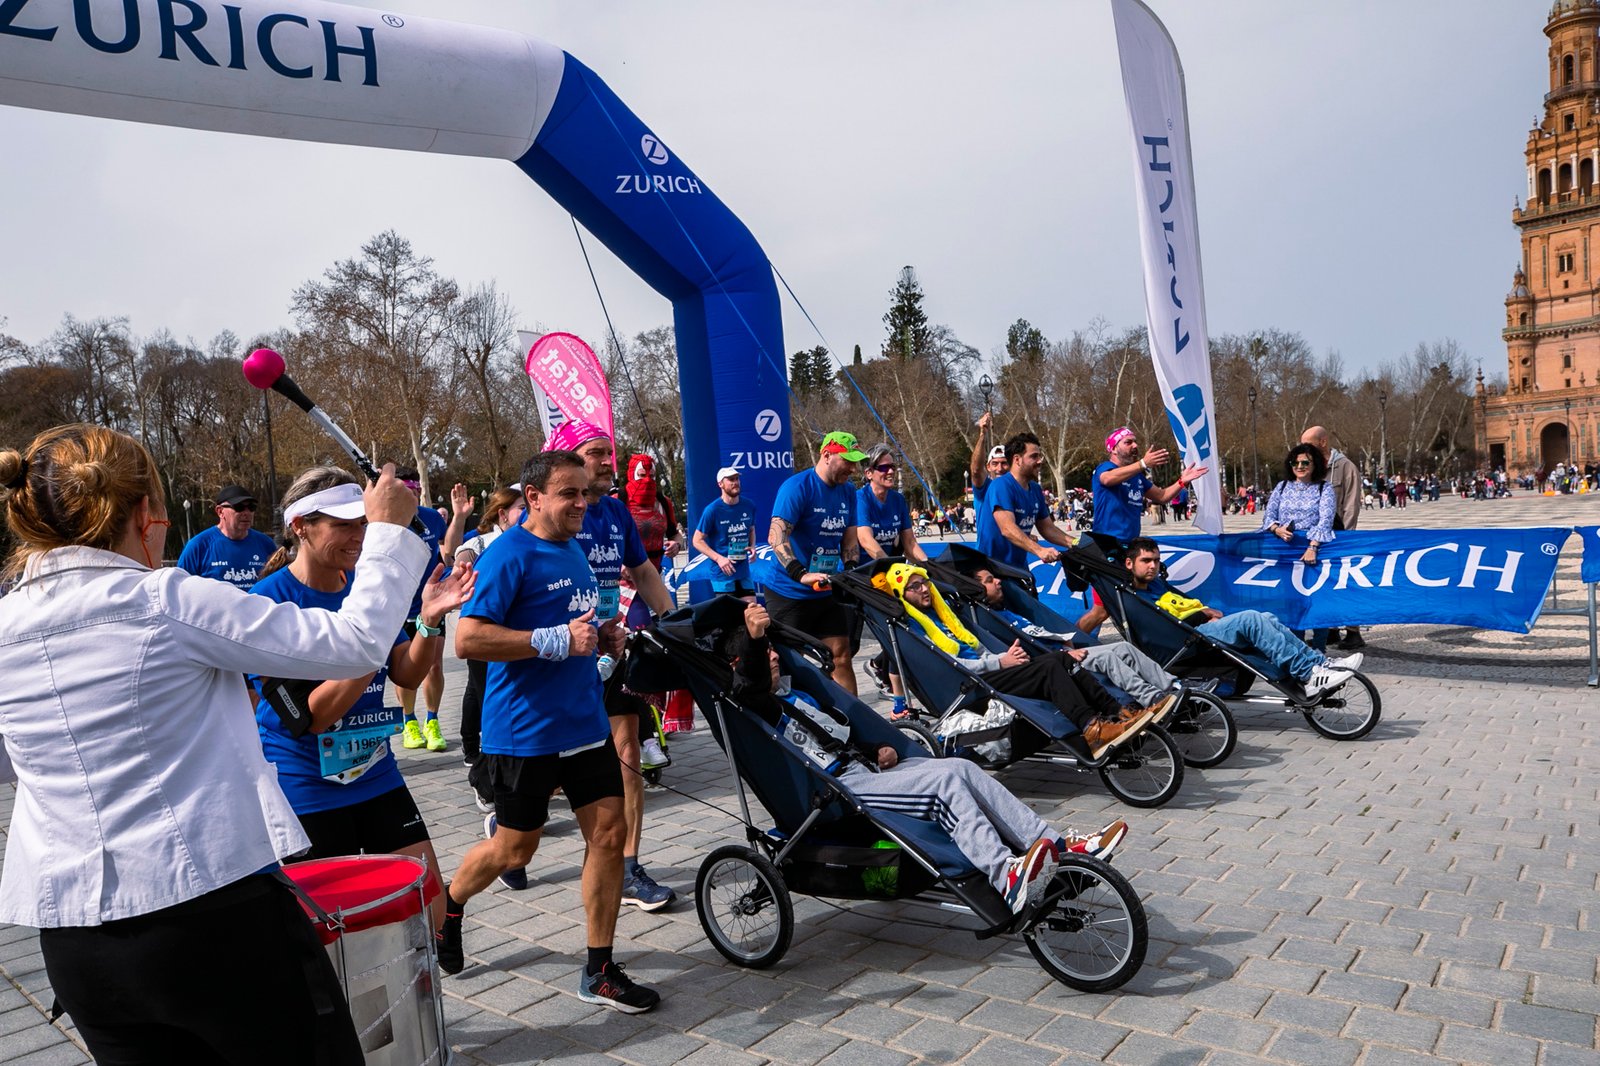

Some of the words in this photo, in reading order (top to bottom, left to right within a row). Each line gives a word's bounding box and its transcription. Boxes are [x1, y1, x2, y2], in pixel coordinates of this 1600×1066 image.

[615, 174, 702, 194] ZURICH
[729, 451, 794, 469] ZURICH
[1233, 543, 1524, 596] ZURICH
[547, 578, 572, 591] aefat
[348, 711, 393, 726] ZURICH
